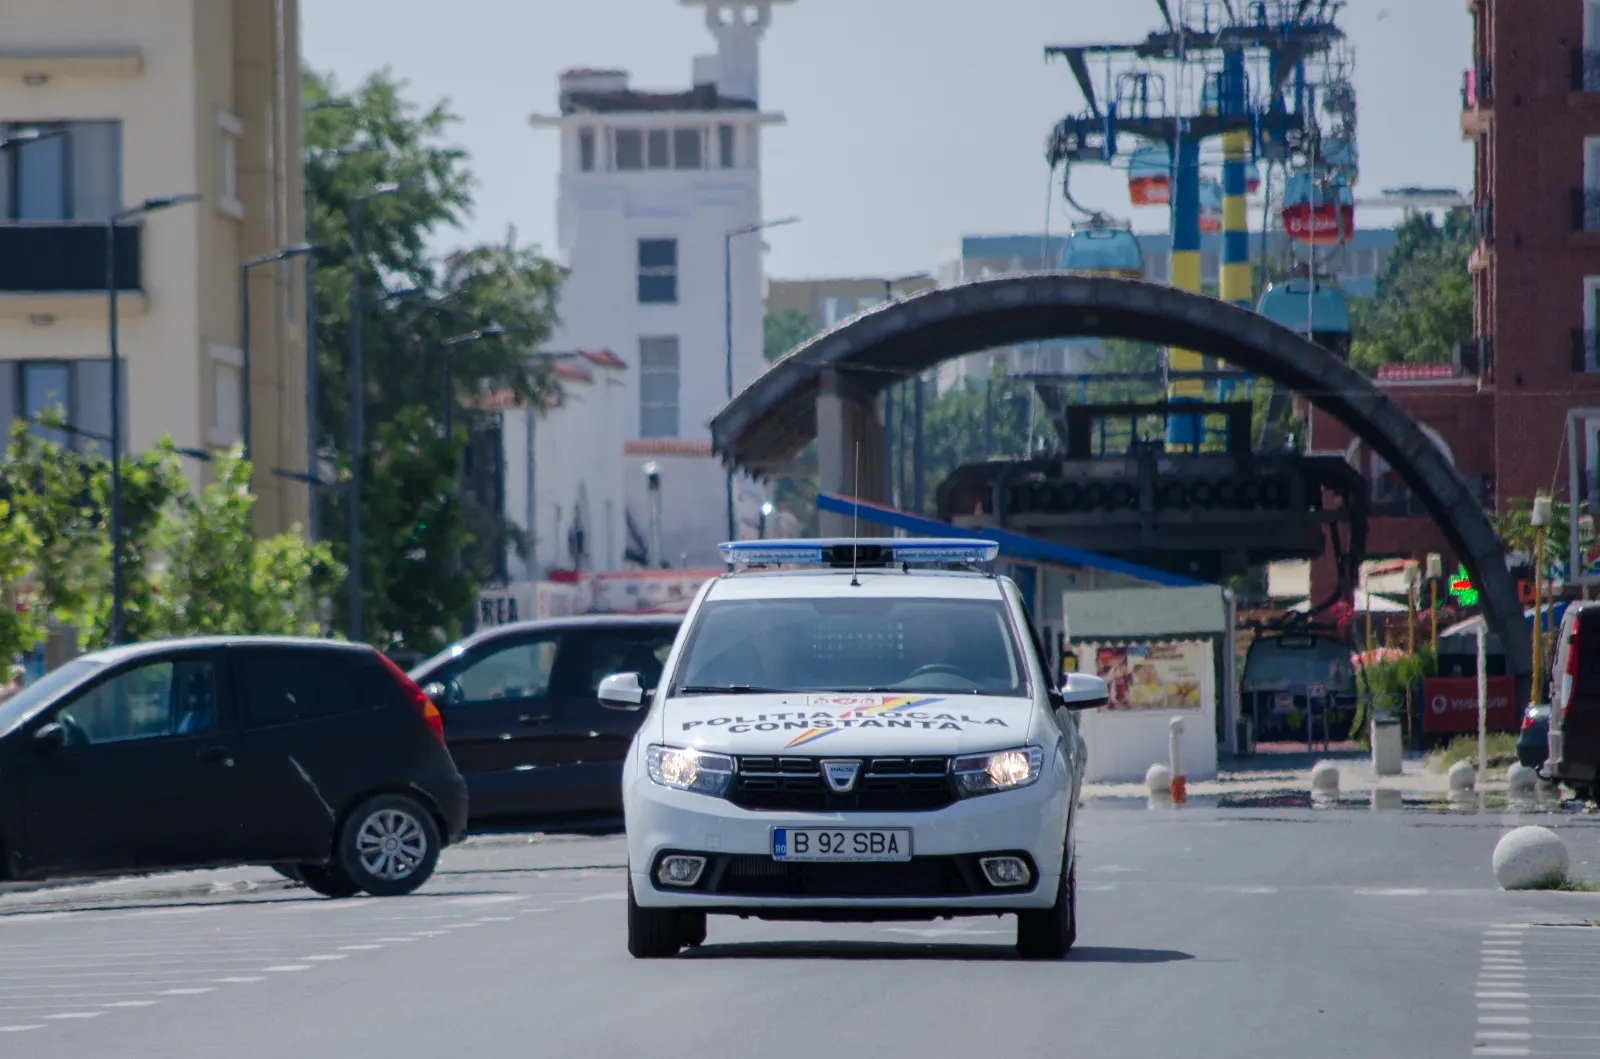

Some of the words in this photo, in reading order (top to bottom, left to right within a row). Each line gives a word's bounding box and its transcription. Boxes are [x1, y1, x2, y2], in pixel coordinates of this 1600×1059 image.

[682, 712, 834, 731] POLITIA
[855, 711, 1009, 728] LOCALA
[728, 719, 964, 734] CONSTANTA
[775, 844, 787, 854] RO
[794, 832, 810, 853] B
[818, 832, 846, 853] 92
[853, 832, 900, 854] SBA
